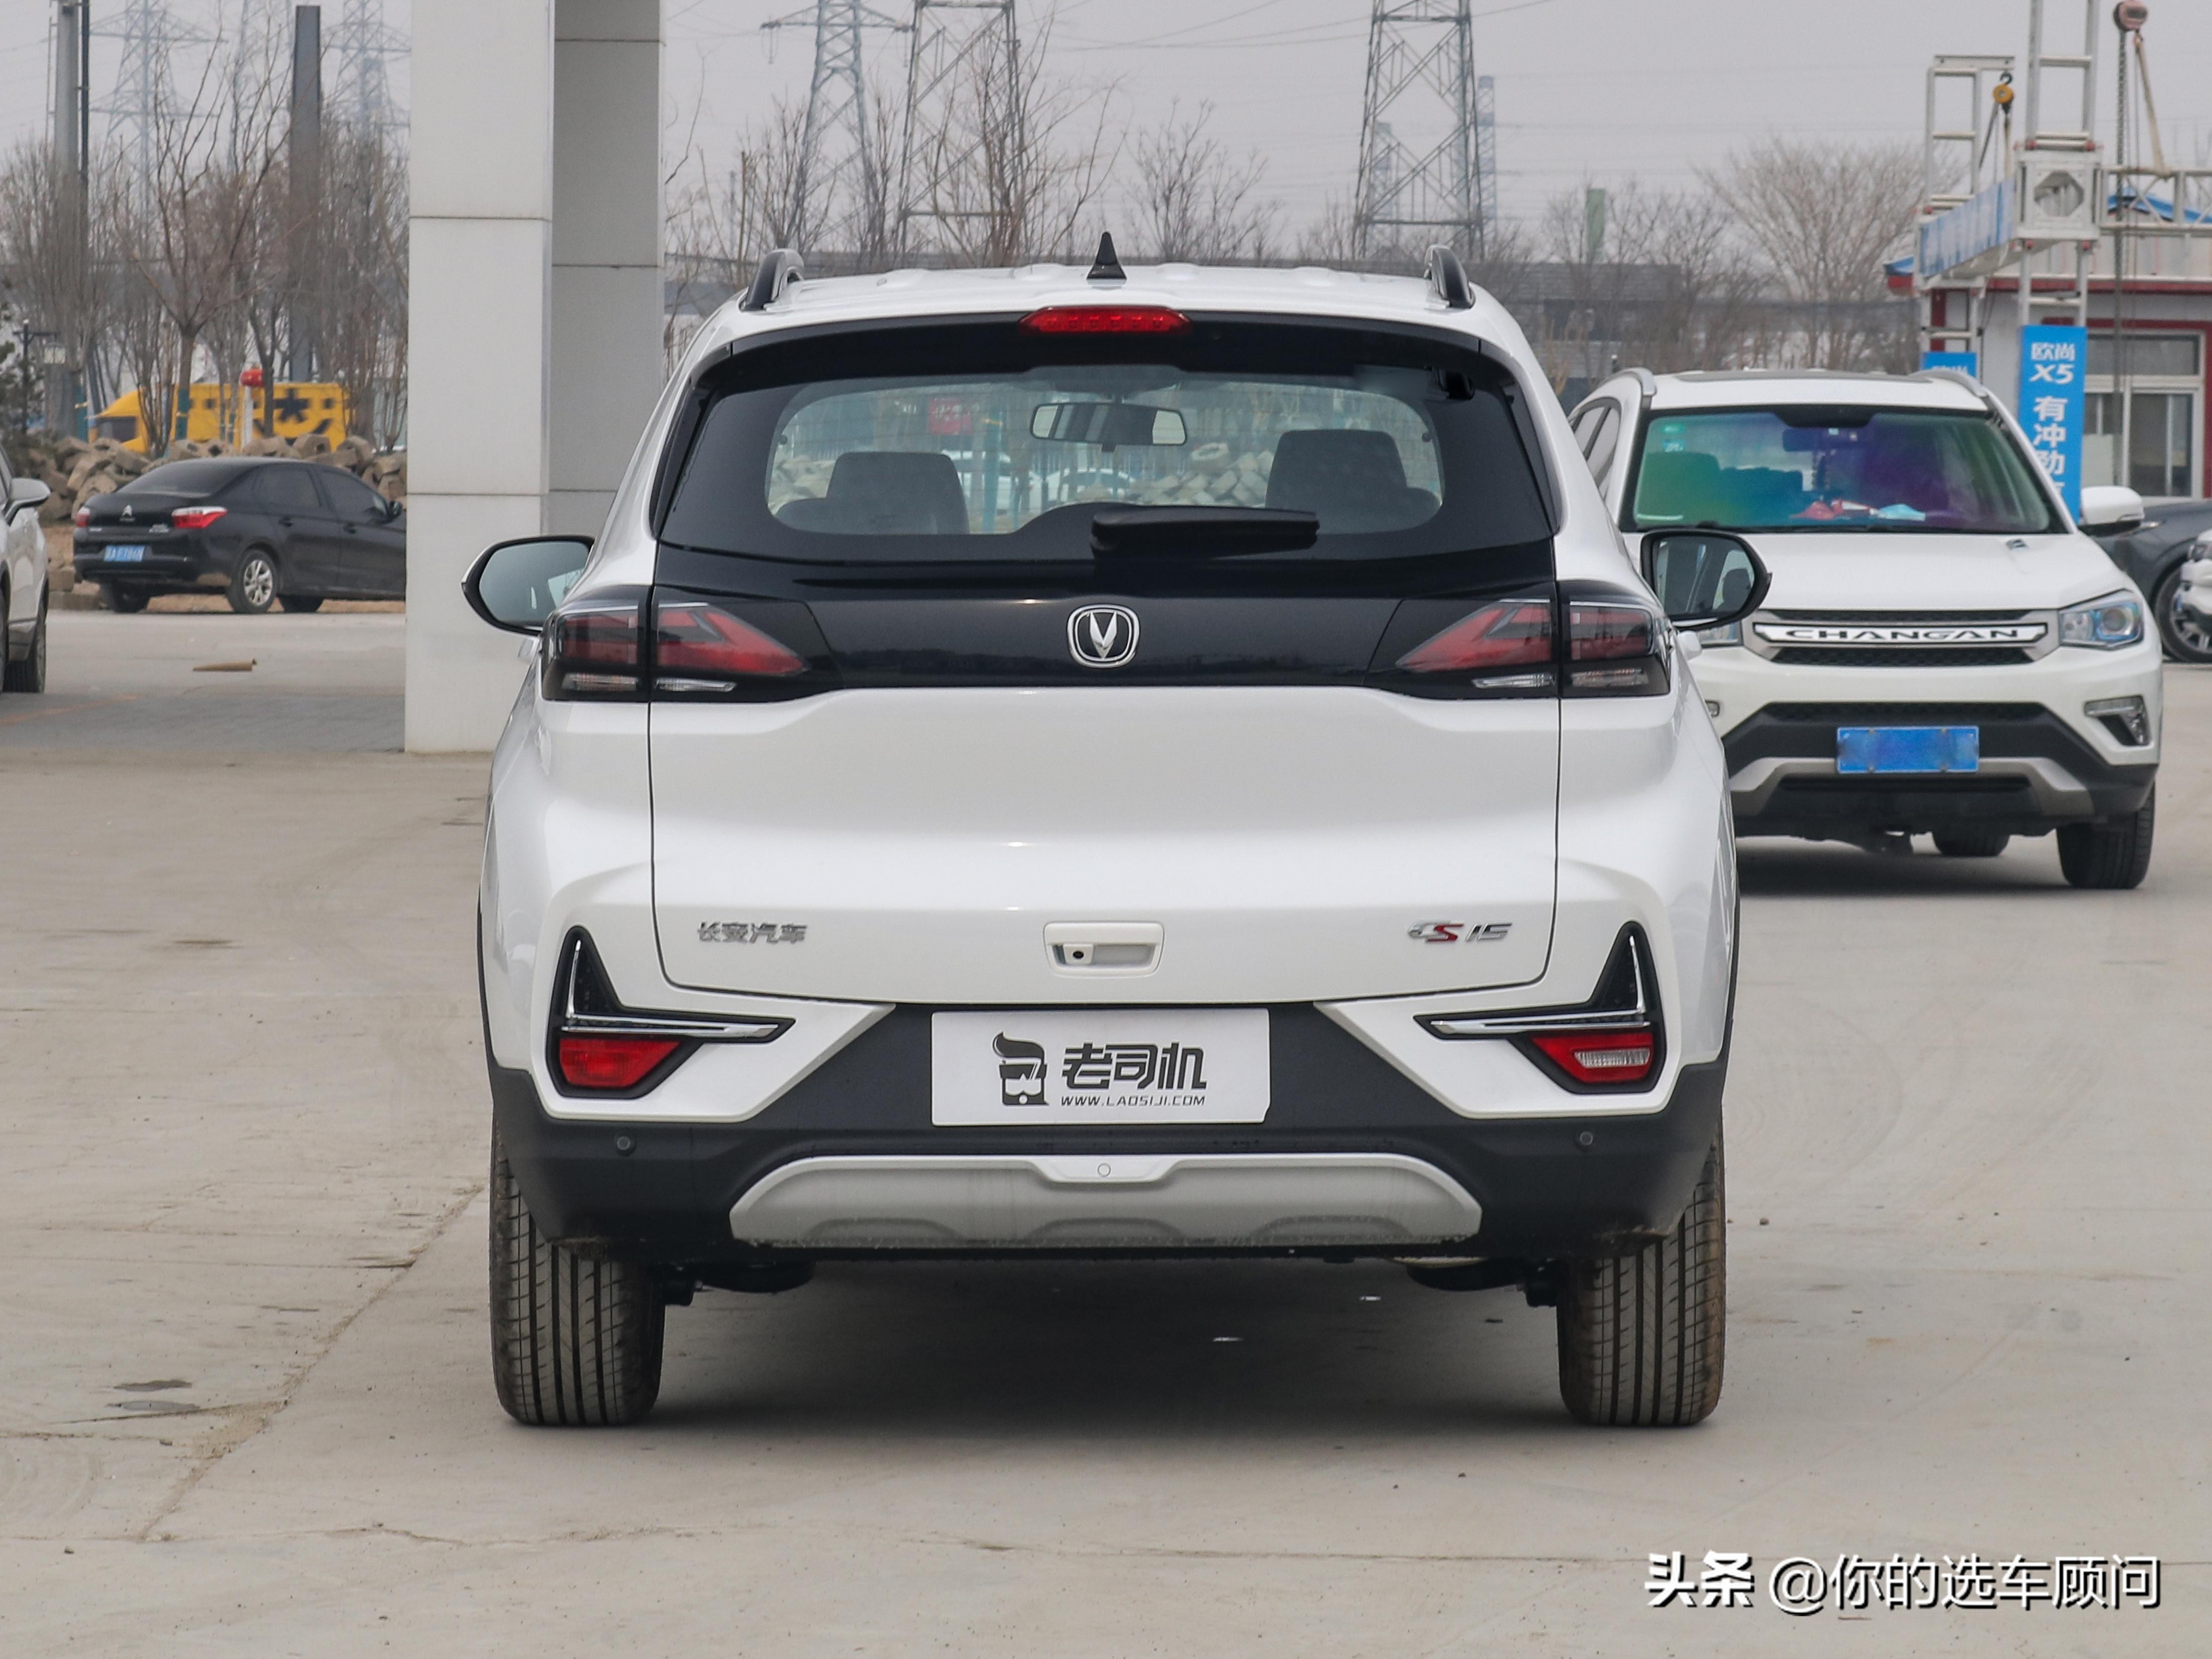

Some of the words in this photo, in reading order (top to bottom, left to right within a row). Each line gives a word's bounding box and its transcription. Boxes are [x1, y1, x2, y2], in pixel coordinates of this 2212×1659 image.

[2031, 342, 2076, 361] 欧尚
[2029, 363, 2075, 385] X5
[2033, 395, 2068, 492] 有冲劲
[1785, 629, 2018, 640] CHANGAN
[697, 921, 807, 944] 长安汽车
[1061, 1042, 1208, 1090] 老司机
[1061, 1095, 1206, 1107] WWW.LAOSIJI.COM
